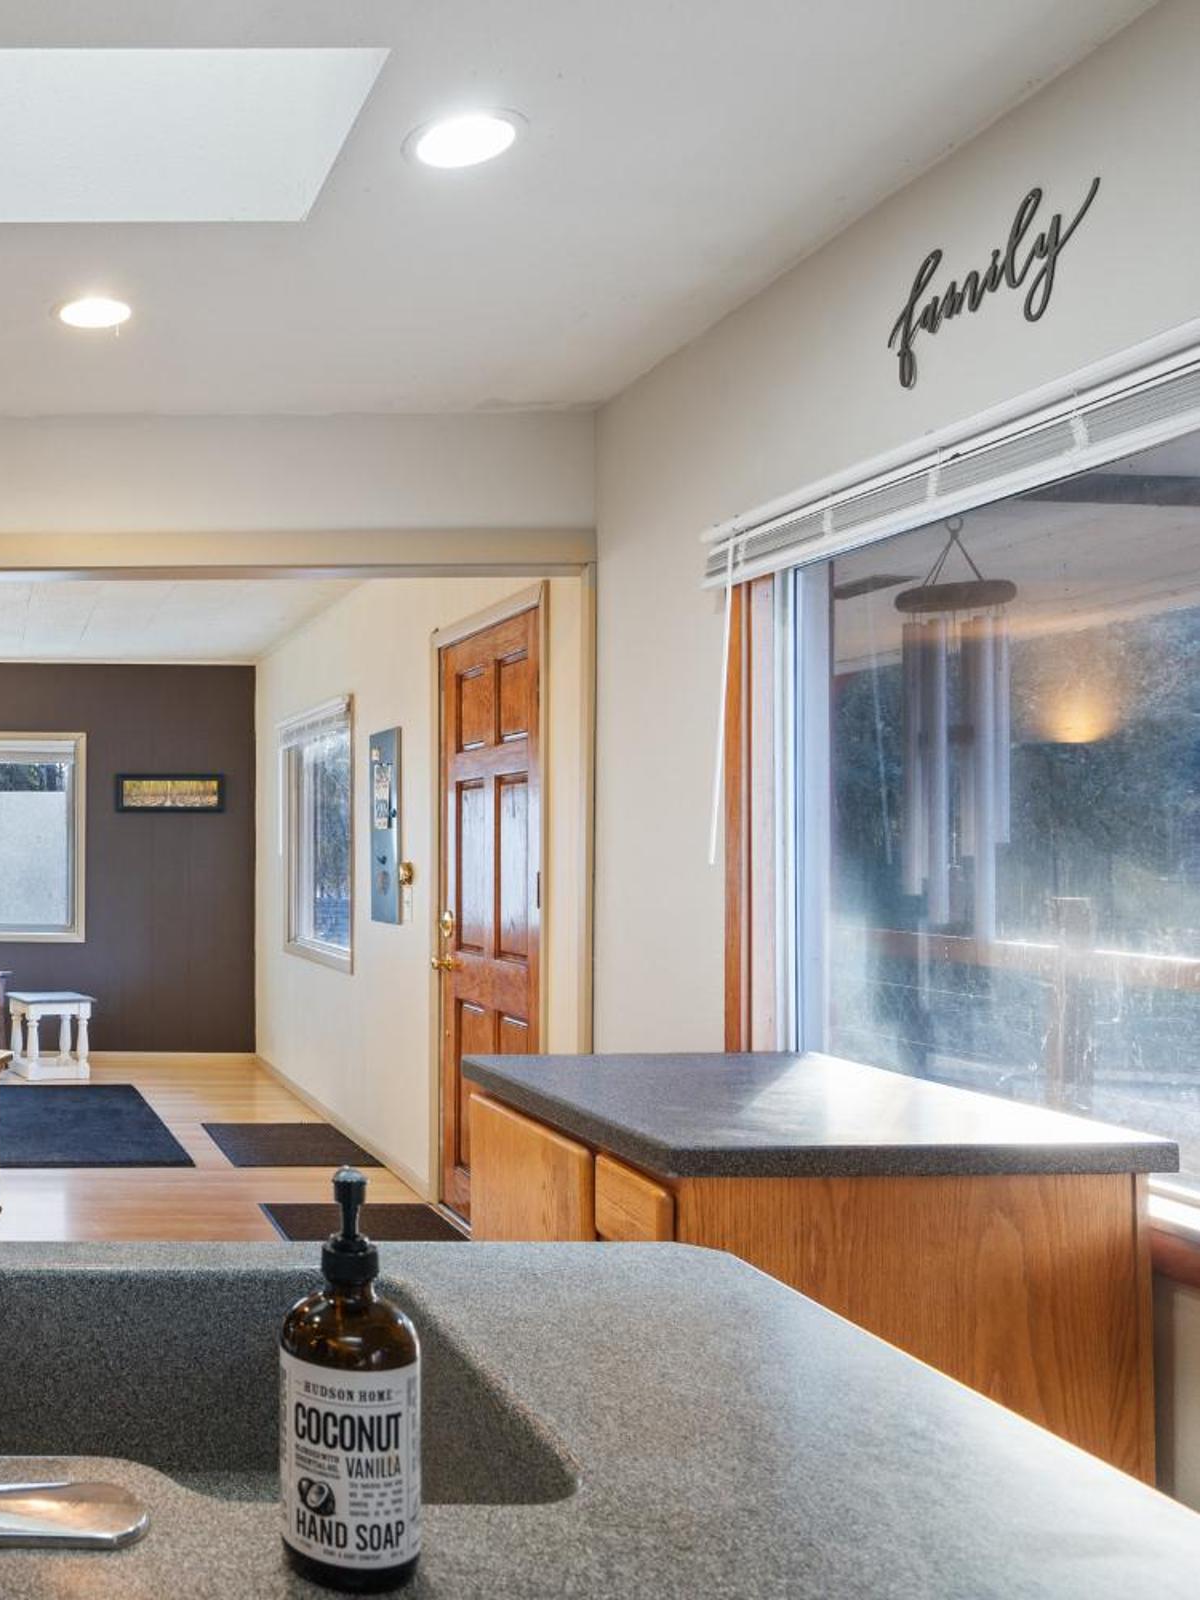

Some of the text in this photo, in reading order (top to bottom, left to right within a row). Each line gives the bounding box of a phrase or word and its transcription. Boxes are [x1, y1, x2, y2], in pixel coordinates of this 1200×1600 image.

[888, 176, 1101, 390] family
[303, 1380, 393, 1403] HUDSON HOME
[294, 1400, 403, 1454] COCONUT
[344, 1454, 402, 1480] VANILLA
[296, 1507, 405, 1552] HAND SOAP
